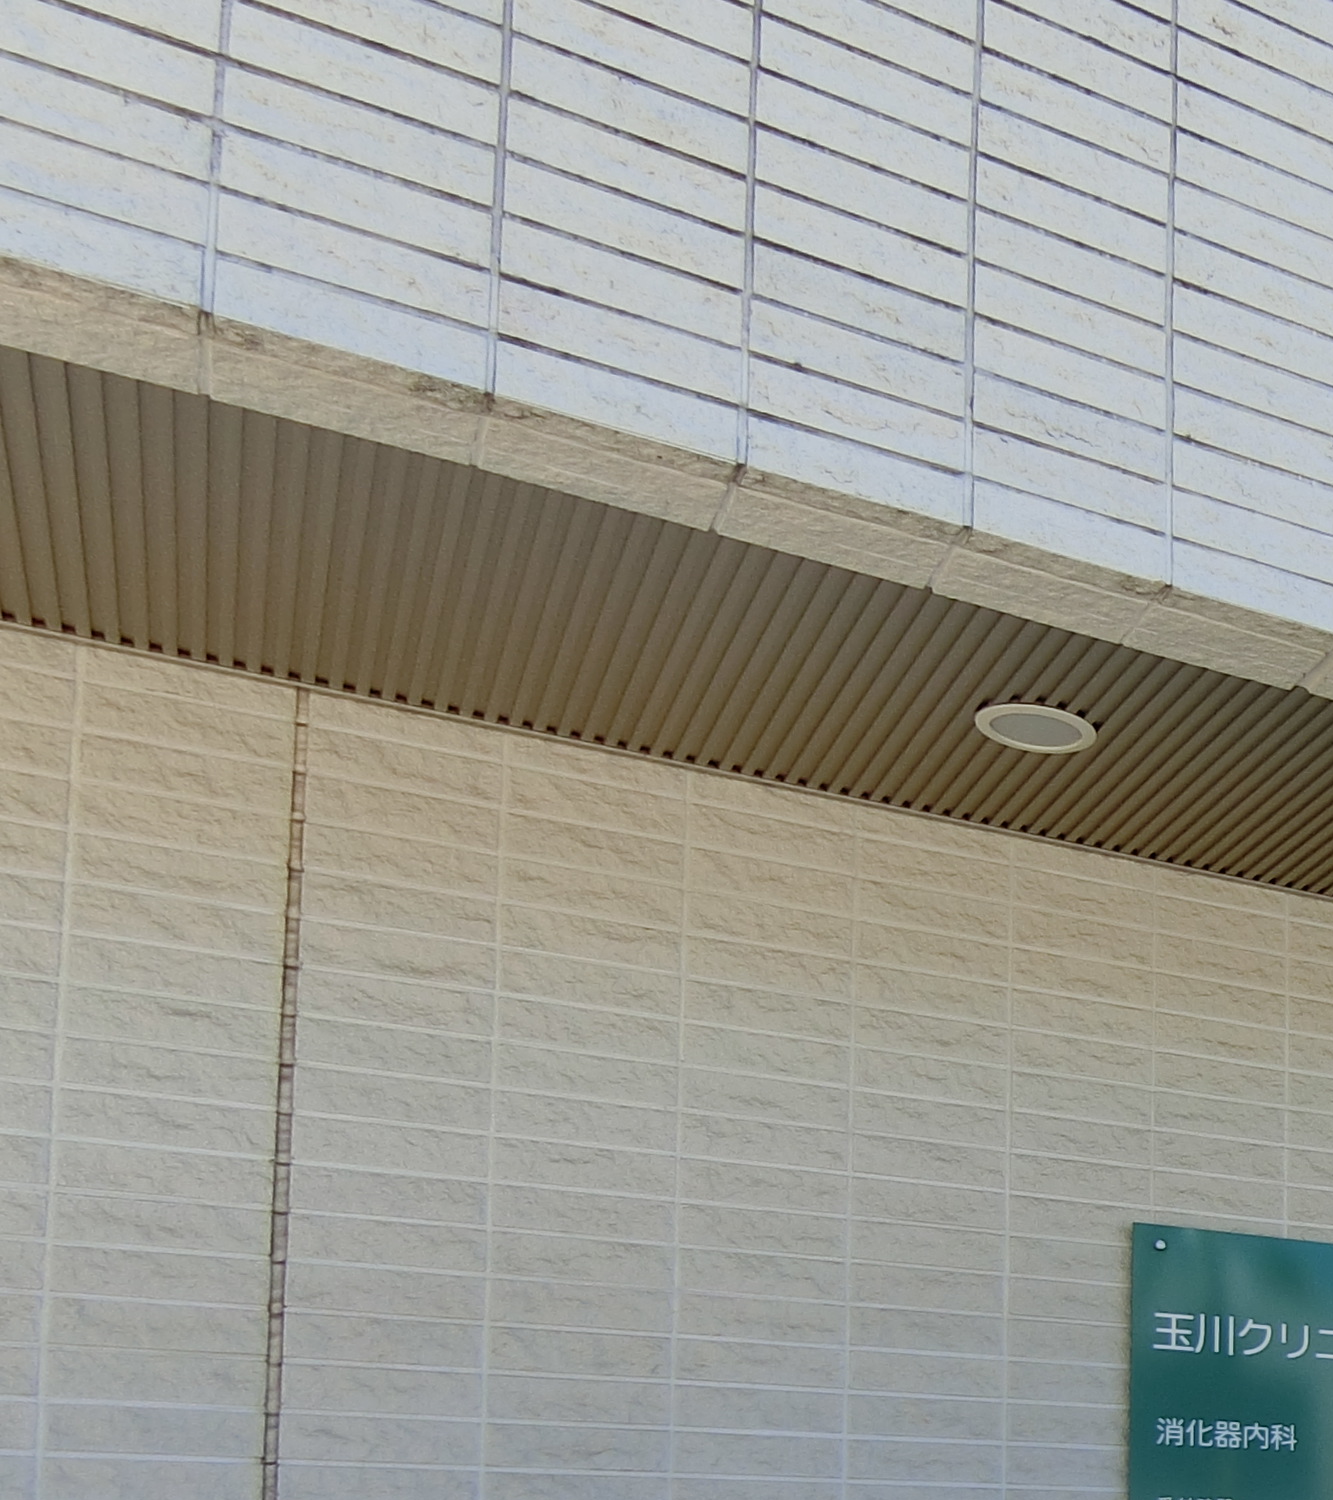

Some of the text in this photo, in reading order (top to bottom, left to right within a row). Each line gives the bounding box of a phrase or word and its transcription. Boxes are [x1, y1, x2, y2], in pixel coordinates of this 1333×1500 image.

[1156, 1417, 1297, 1452] 消化器内科
